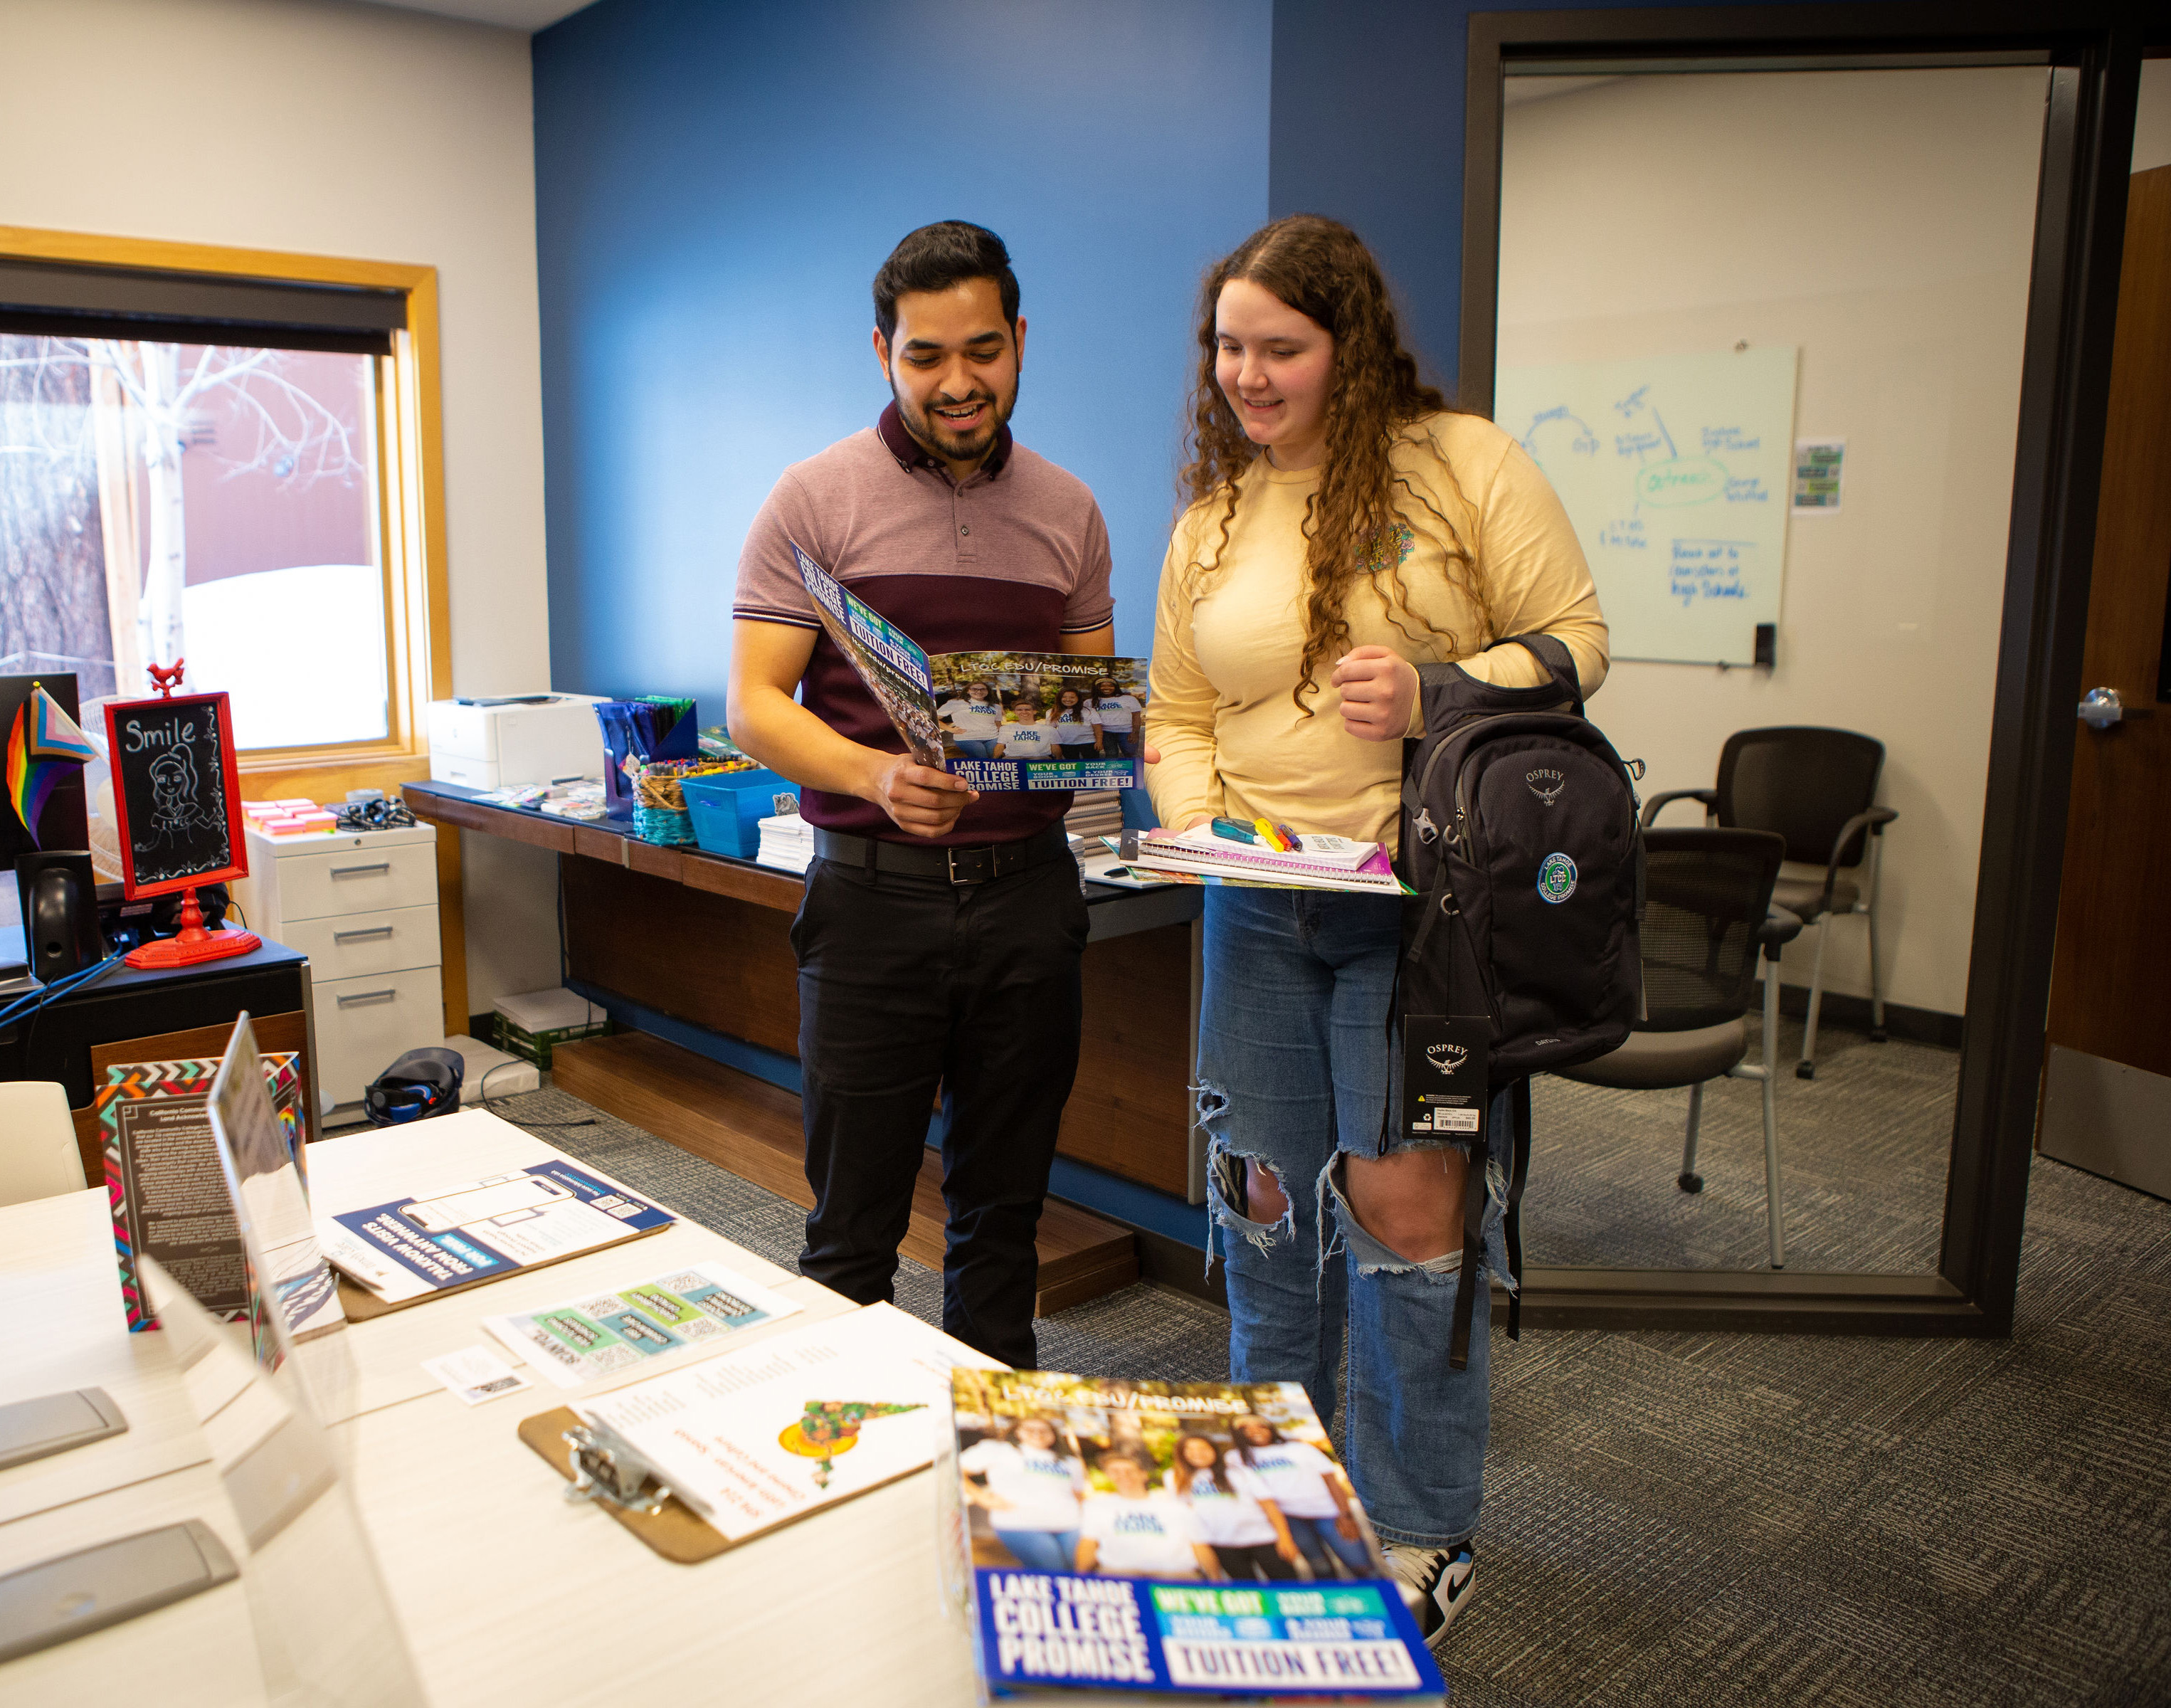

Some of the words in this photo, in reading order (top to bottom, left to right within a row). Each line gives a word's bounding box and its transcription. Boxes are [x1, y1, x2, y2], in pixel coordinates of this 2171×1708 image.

[796, 549, 815, 574] LAKE
[815, 566, 840, 596] TAHOE
[800, 561, 843, 611] COLLEGE
[804, 574, 847, 625] PROMISE
[847, 596, 867, 621] WE'VE
[869, 612, 883, 628] GOT
[851, 636, 921, 695] ltcc.edu/promise
[852, 619, 894, 662] TUITION
[897, 655, 926, 687] FREE!
[125, 717, 196, 753] Smile
[954, 761, 981, 770] LAKE
[983, 761, 1018, 771] TAHOE
[1526, 769, 1564, 782] OSPREY
[968, 782, 1020, 791] ROMISE
[1032, 779, 1087, 789] TUITION
[1092, 777, 1129, 788] FREE!
[1544, 857, 1557, 870] LAKE
[1556, 855, 1573, 868] TAHOE
[1541, 882, 1557, 900] COLLEGE
[1558, 880, 1575, 900] PROMISE
[1550, 875, 1566, 884] LTCC
[1427, 1044, 1469, 1056] OSPREY
[361, 1221, 400, 1246] VISITS
[376, 1213, 441, 1255] ANYWHERE.
[393, 1243, 453, 1281] TALKNOW
[432, 1249, 474, 1275] FROM
[464, 1250, 494, 1266] FOR
[989, 1573, 1056, 1602] LAKE
[1054, 1575, 1135, 1607] TAHOE
[1217, 1589, 1265, 1615] GOT
[993, 1601, 1142, 1640] COLLEGE
[998, 1634, 1156, 1684] PROMISE
[1178, 1645, 1308, 1677] TUITION
[1315, 1647, 1406, 1677] FREE!
